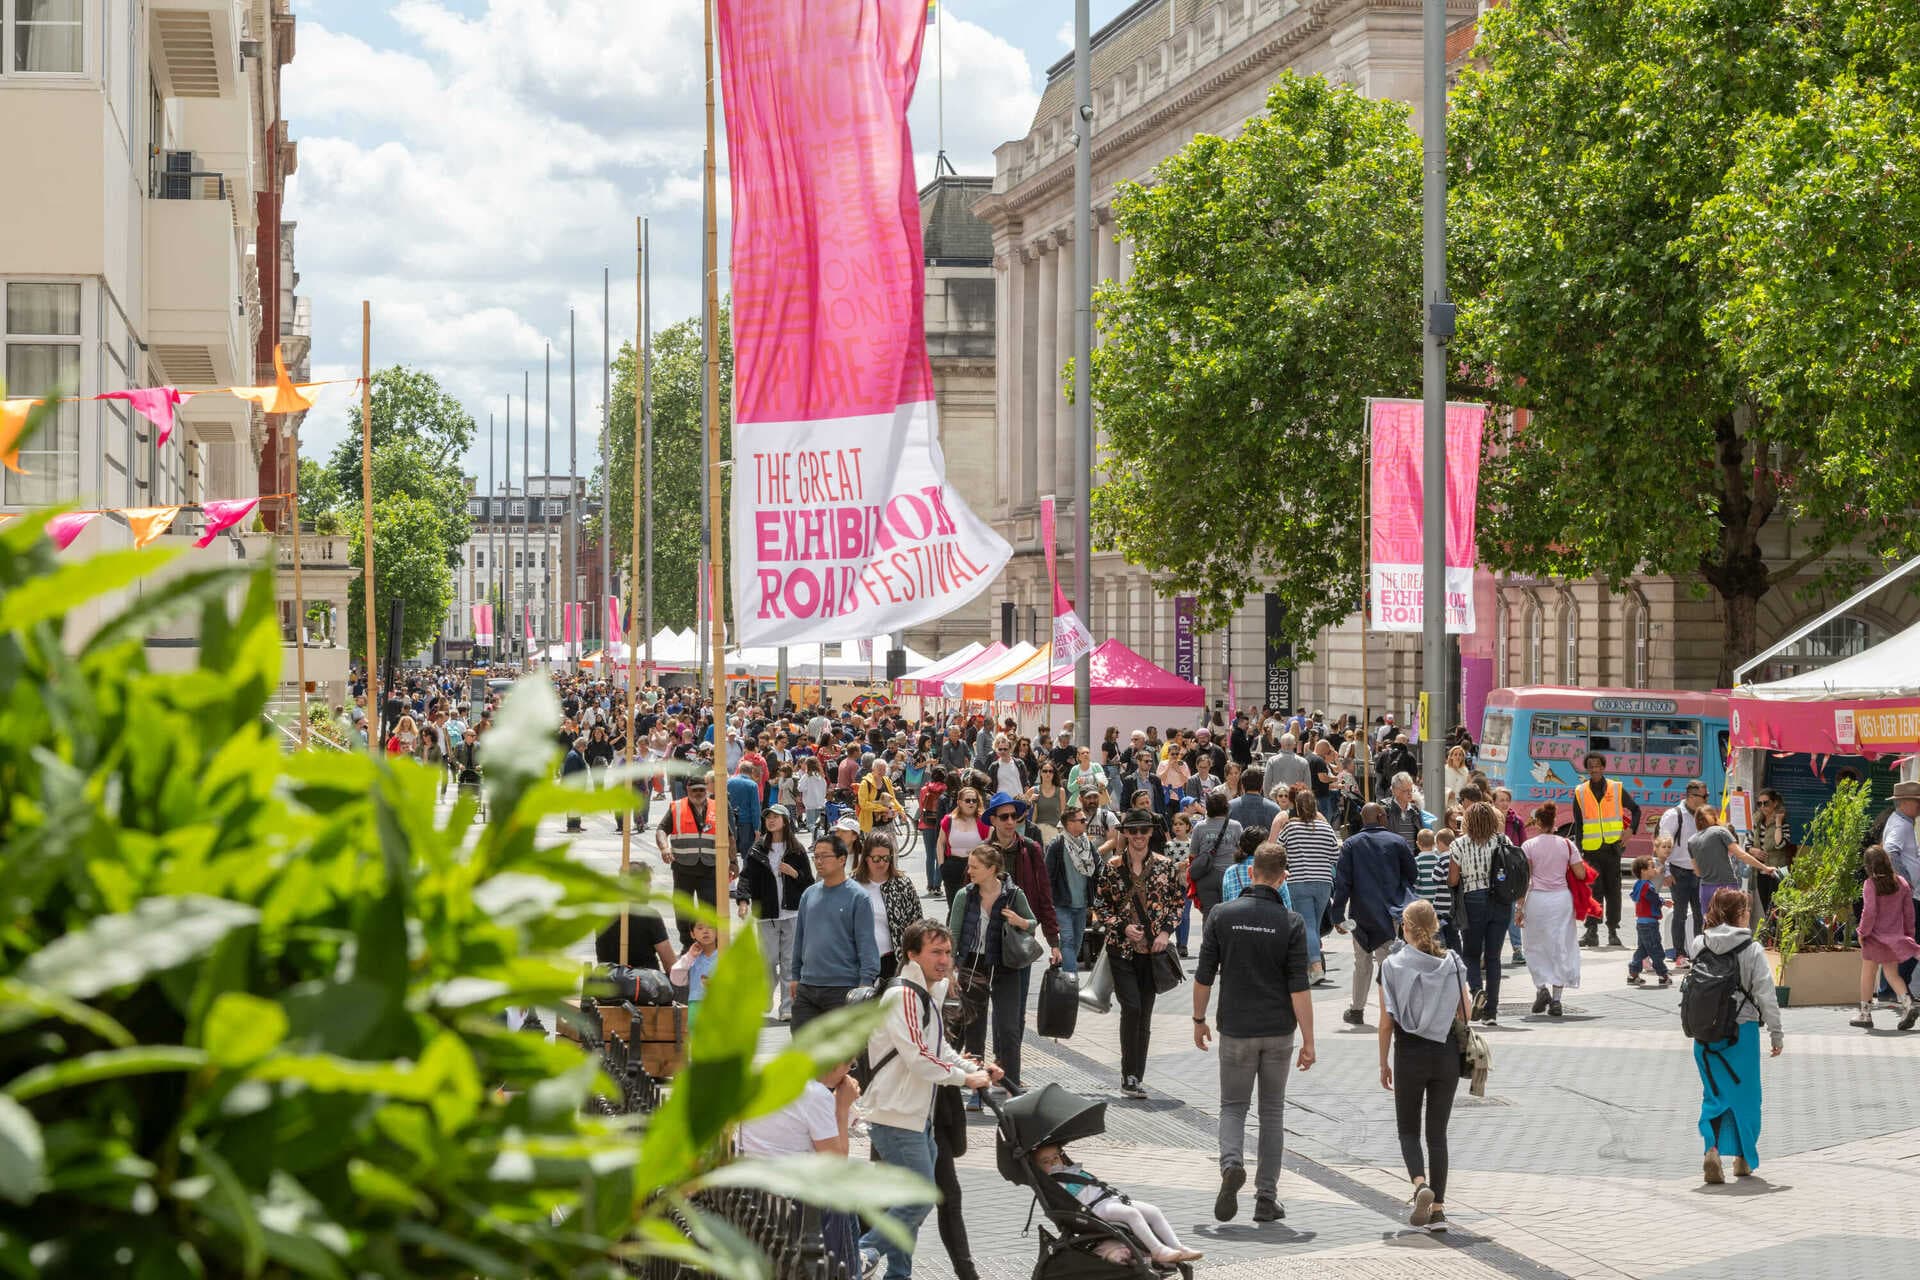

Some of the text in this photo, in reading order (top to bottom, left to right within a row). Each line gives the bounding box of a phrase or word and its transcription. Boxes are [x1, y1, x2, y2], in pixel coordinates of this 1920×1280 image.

[753, 447, 864, 504] THE GREAT
[755, 485, 957, 562] EXHIBION
[756, 541, 990, 620] ROAD FESTIVAL
[1381, 572, 1423, 589] THE GREA
[1381, 607, 1423, 623] ROA
[1179, 638, 1192, 650] IT
[1179, 654, 1192, 682] URN
[1279, 665, 1290, 709] MUSEU
[1528, 786, 1575, 799] SUPE
